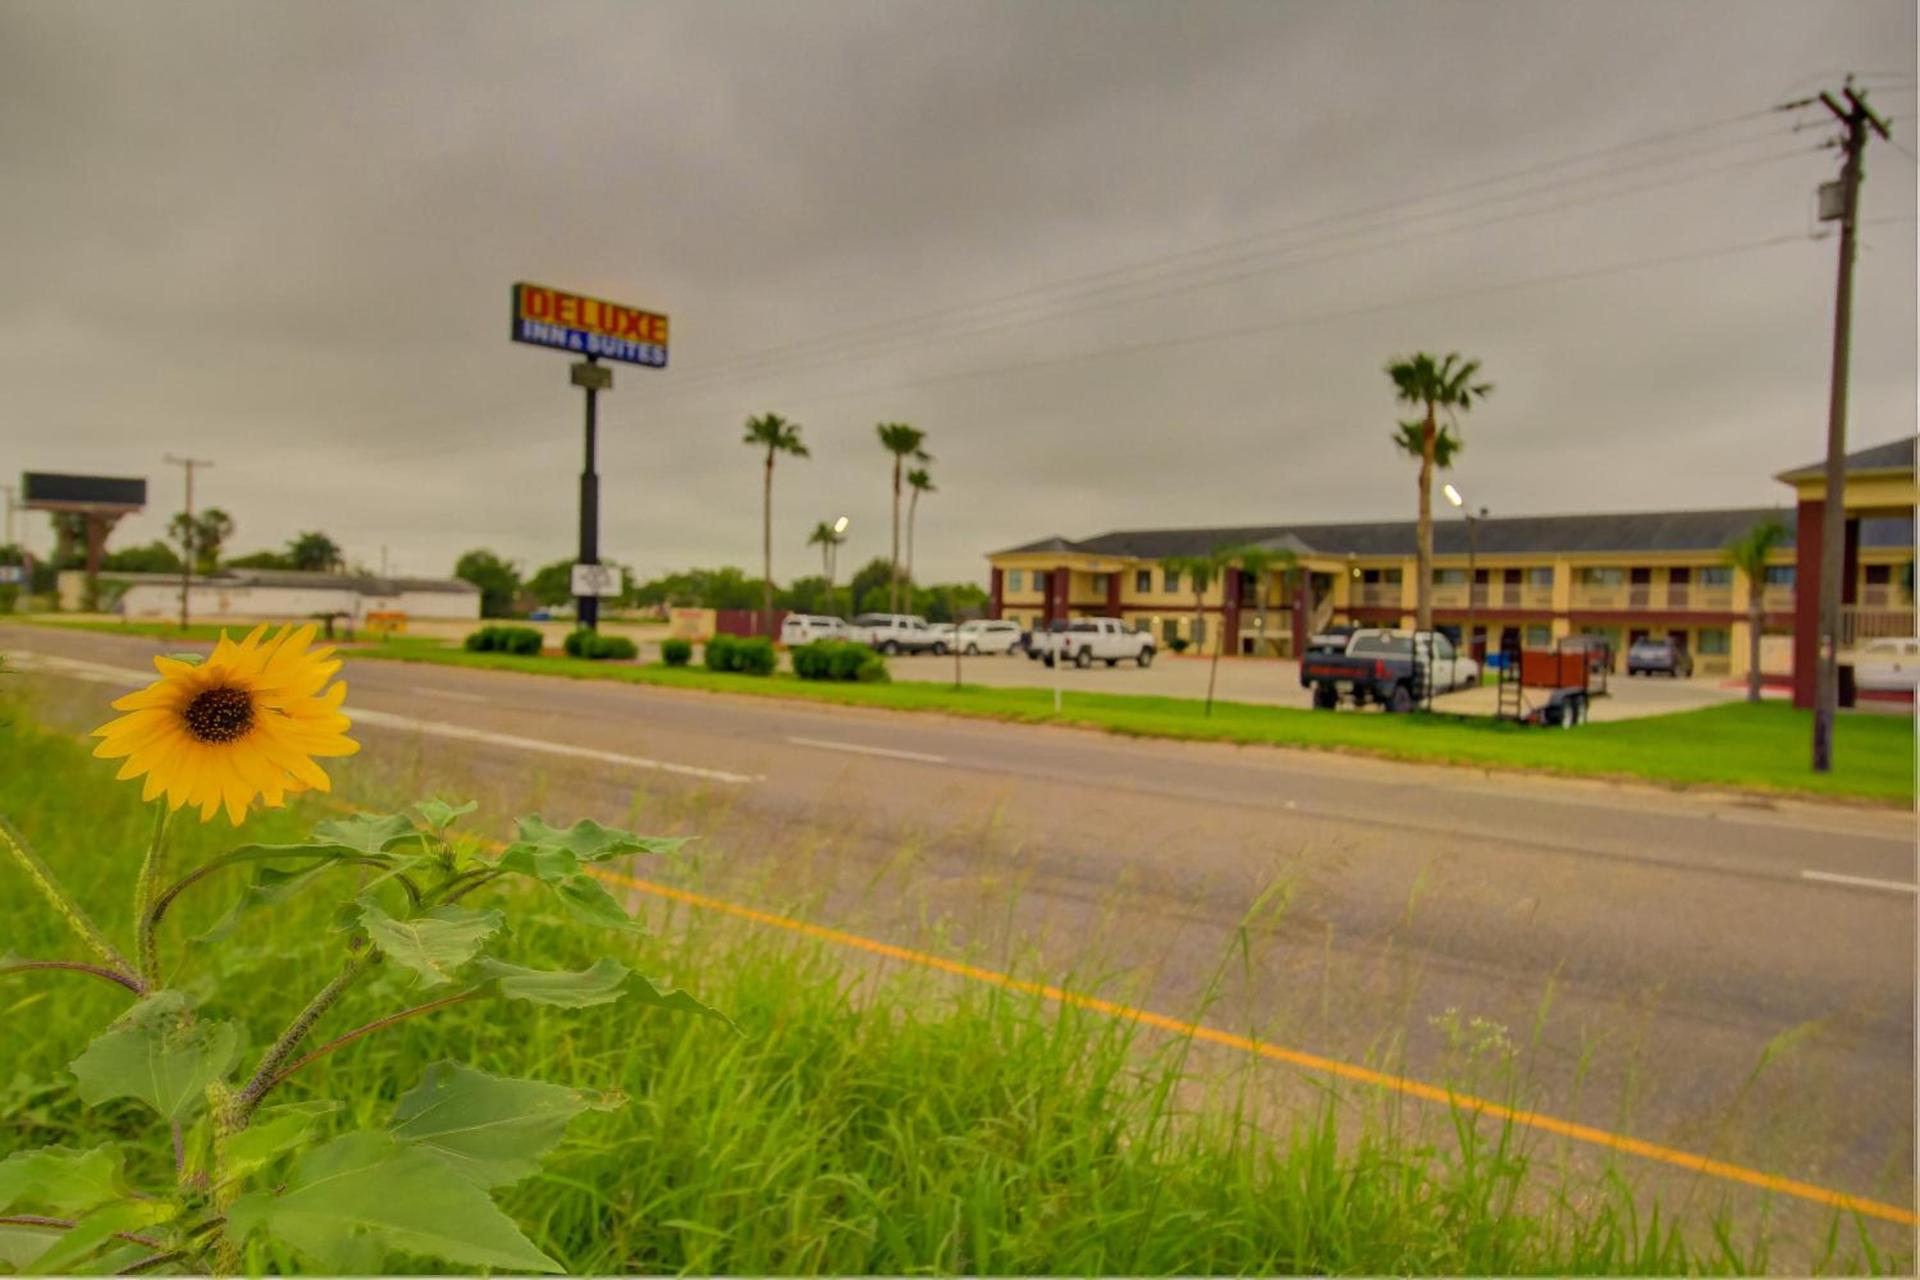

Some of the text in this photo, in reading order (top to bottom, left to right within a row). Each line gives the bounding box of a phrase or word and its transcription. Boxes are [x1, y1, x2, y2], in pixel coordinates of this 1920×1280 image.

[526, 287, 667, 341] DELUXE
[524, 320, 566, 346] INN
[587, 331, 665, 365] SUITES
